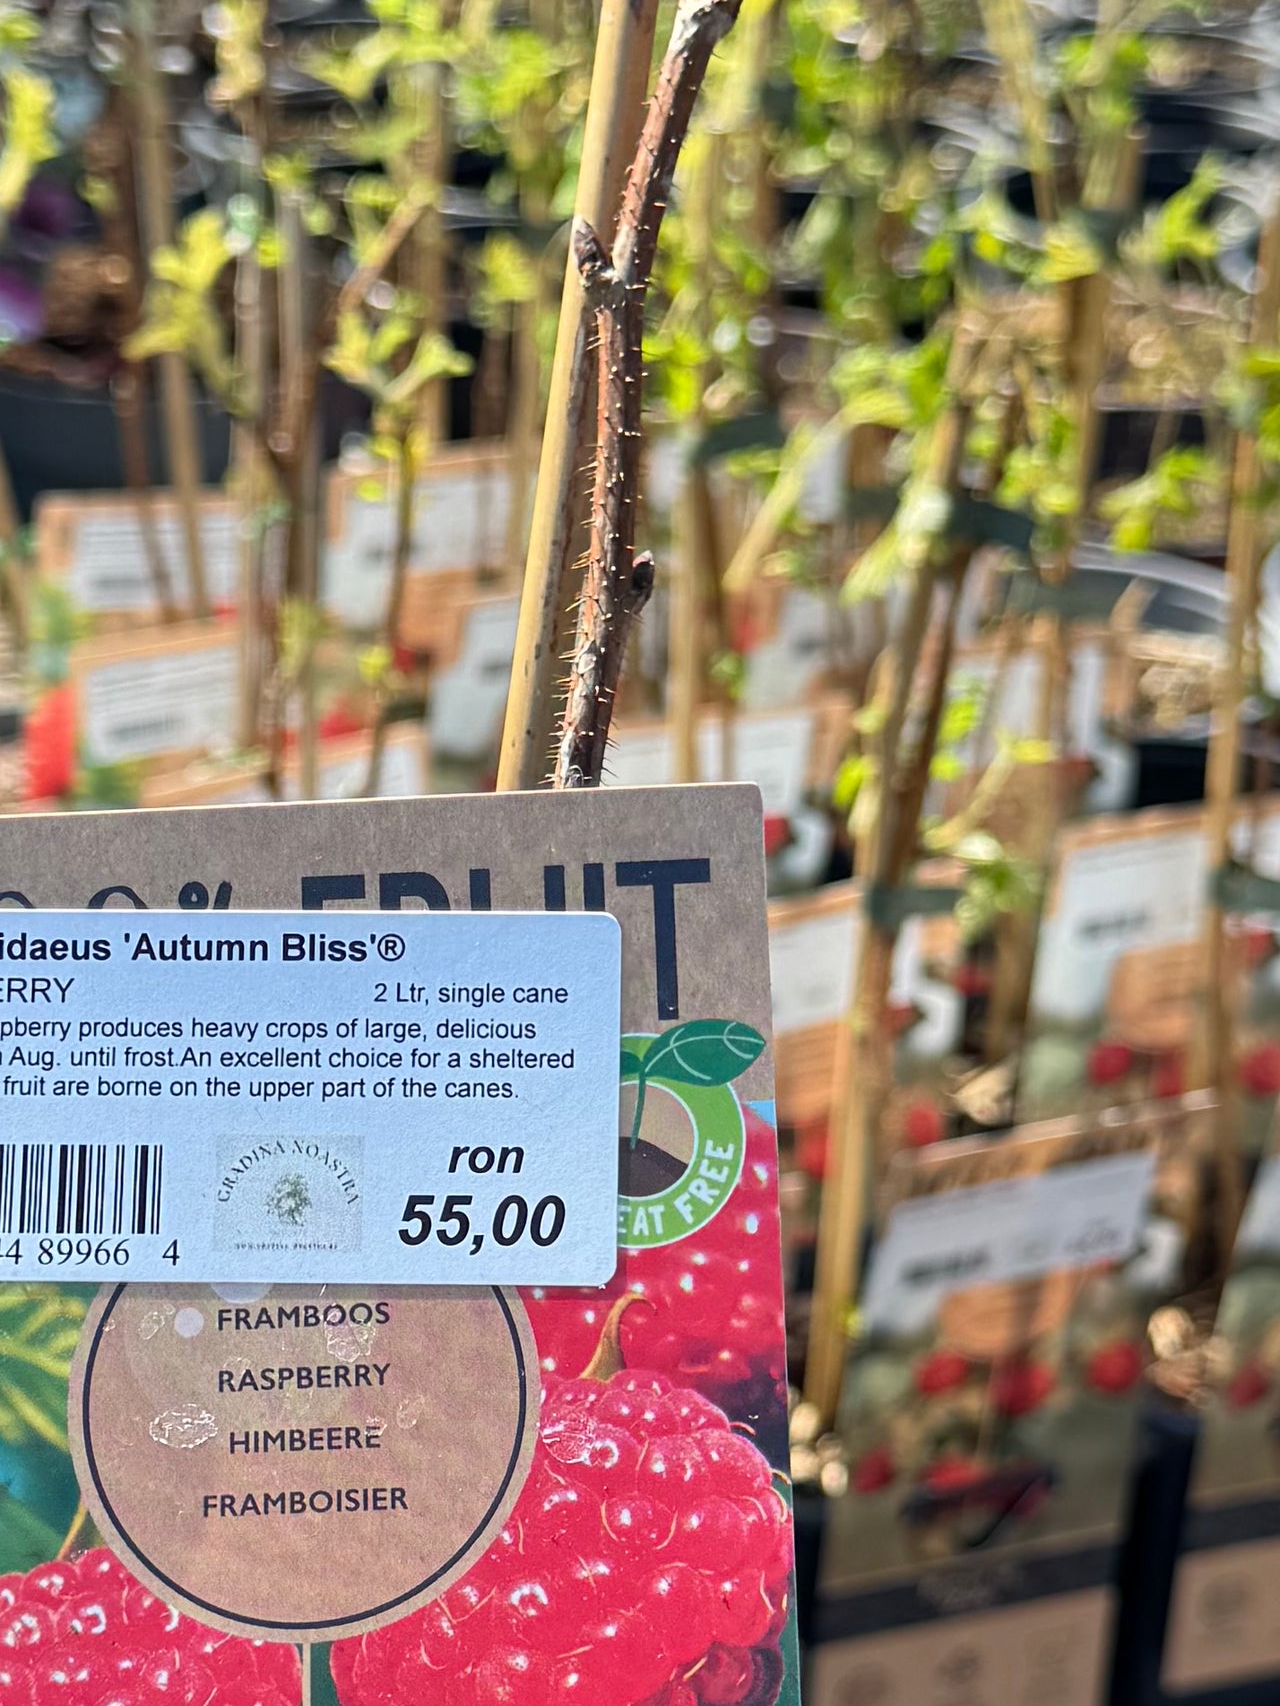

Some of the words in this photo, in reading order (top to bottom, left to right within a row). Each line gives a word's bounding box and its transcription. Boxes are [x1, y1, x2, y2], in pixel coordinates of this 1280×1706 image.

[124, 933, 269, 962] 'Autumn
[373, 983, 388, 1003] 2
[396, 983, 429, 1005] Ltr,
[438, 983, 505, 1007] single
[512, 987, 569, 1003] cane
[78, 1018, 183, 1042] produces
[192, 1018, 259, 1042] heavy
[266, 1021, 328, 1043] crops
[336, 1018, 358, 1038] of
[365, 1018, 427, 1043] large,
[436, 1019, 536, 1039] delicious
[9, 1047, 61, 1071] Aug.
[70, 1047, 116, 1067] until
[220, 1048, 322, 1068] excellent
[328, 1049, 403, 1068] choice
[411, 1049, 441, 1068] for
[448, 1053, 461, 1069] a
[470, 1049, 575, 1069] sheltered
[4, 1076, 46, 1096] fruit
[53, 1081, 90, 1096] are
[97, 1077, 162, 1097] borne
[169, 1081, 198, 1097] on
[205, 1077, 241, 1097] the
[249, 1081, 314, 1102] upper
[321, 1079, 365, 1102] part
[373, 1077, 396, 1097] of
[402, 1078, 437, 1098] the
[444, 1083, 519, 1099] canes.
[448, 1145, 524, 1173] ron
[617, 1204, 665, 1236] EAT
[673, 1139, 735, 1224] FREE
[398, 1194, 566, 1255] 55,00
[37, 1238, 130, 1266] 89966
[162, 1239, 180, 1266] 4
[217, 1302, 391, 1331] FRAMBOOS
[217, 1363, 391, 1393] RASPBERRY
[229, 1426, 382, 1454] HIMBEERE
[202, 1487, 409, 1517] FRAMBOISIER
